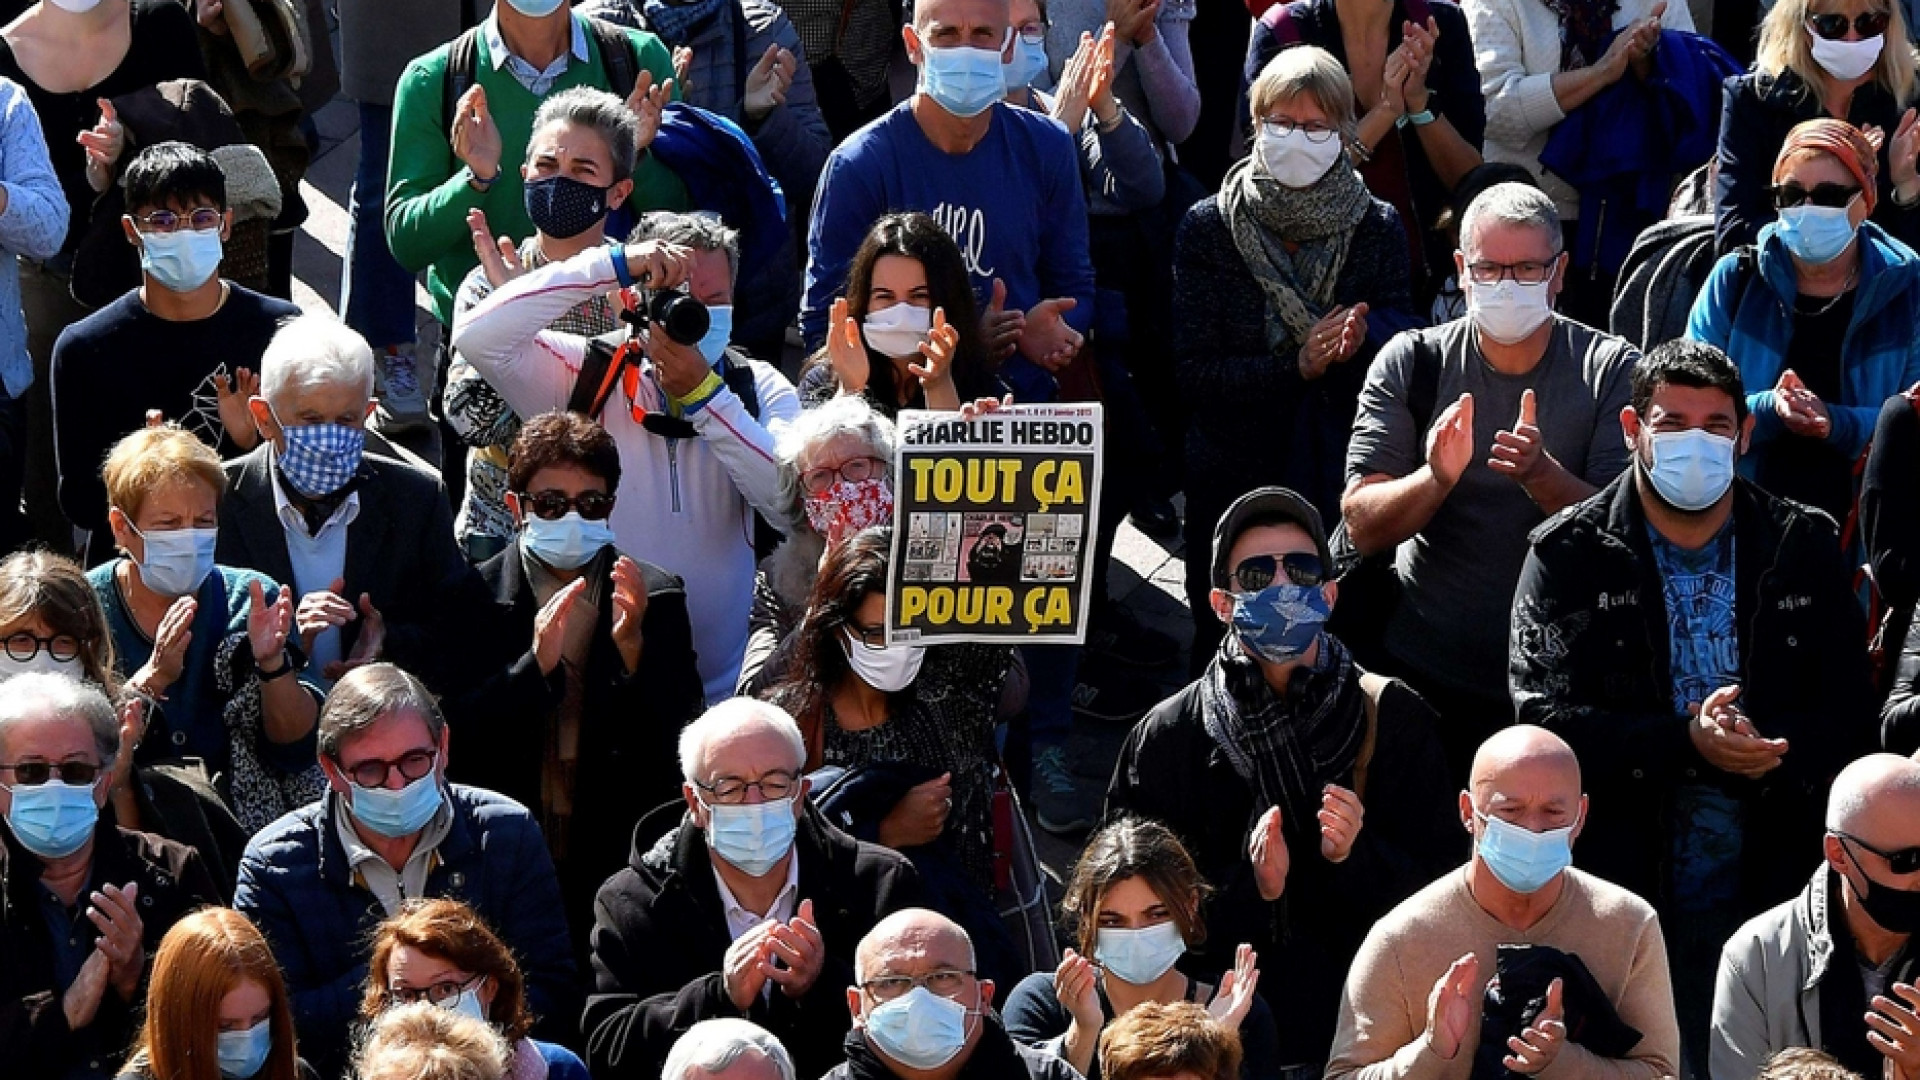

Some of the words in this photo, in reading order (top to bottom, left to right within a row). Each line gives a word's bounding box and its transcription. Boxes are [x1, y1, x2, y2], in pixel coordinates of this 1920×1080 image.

[904, 421, 1003, 445] CHARLIE
[1011, 421, 1095, 445] HEBDO
[910, 458, 1022, 503] TOUT
[1032, 461, 1084, 512] ÇA
[900, 586, 1014, 625] POUR
[1023, 586, 1071, 634] ÇA
